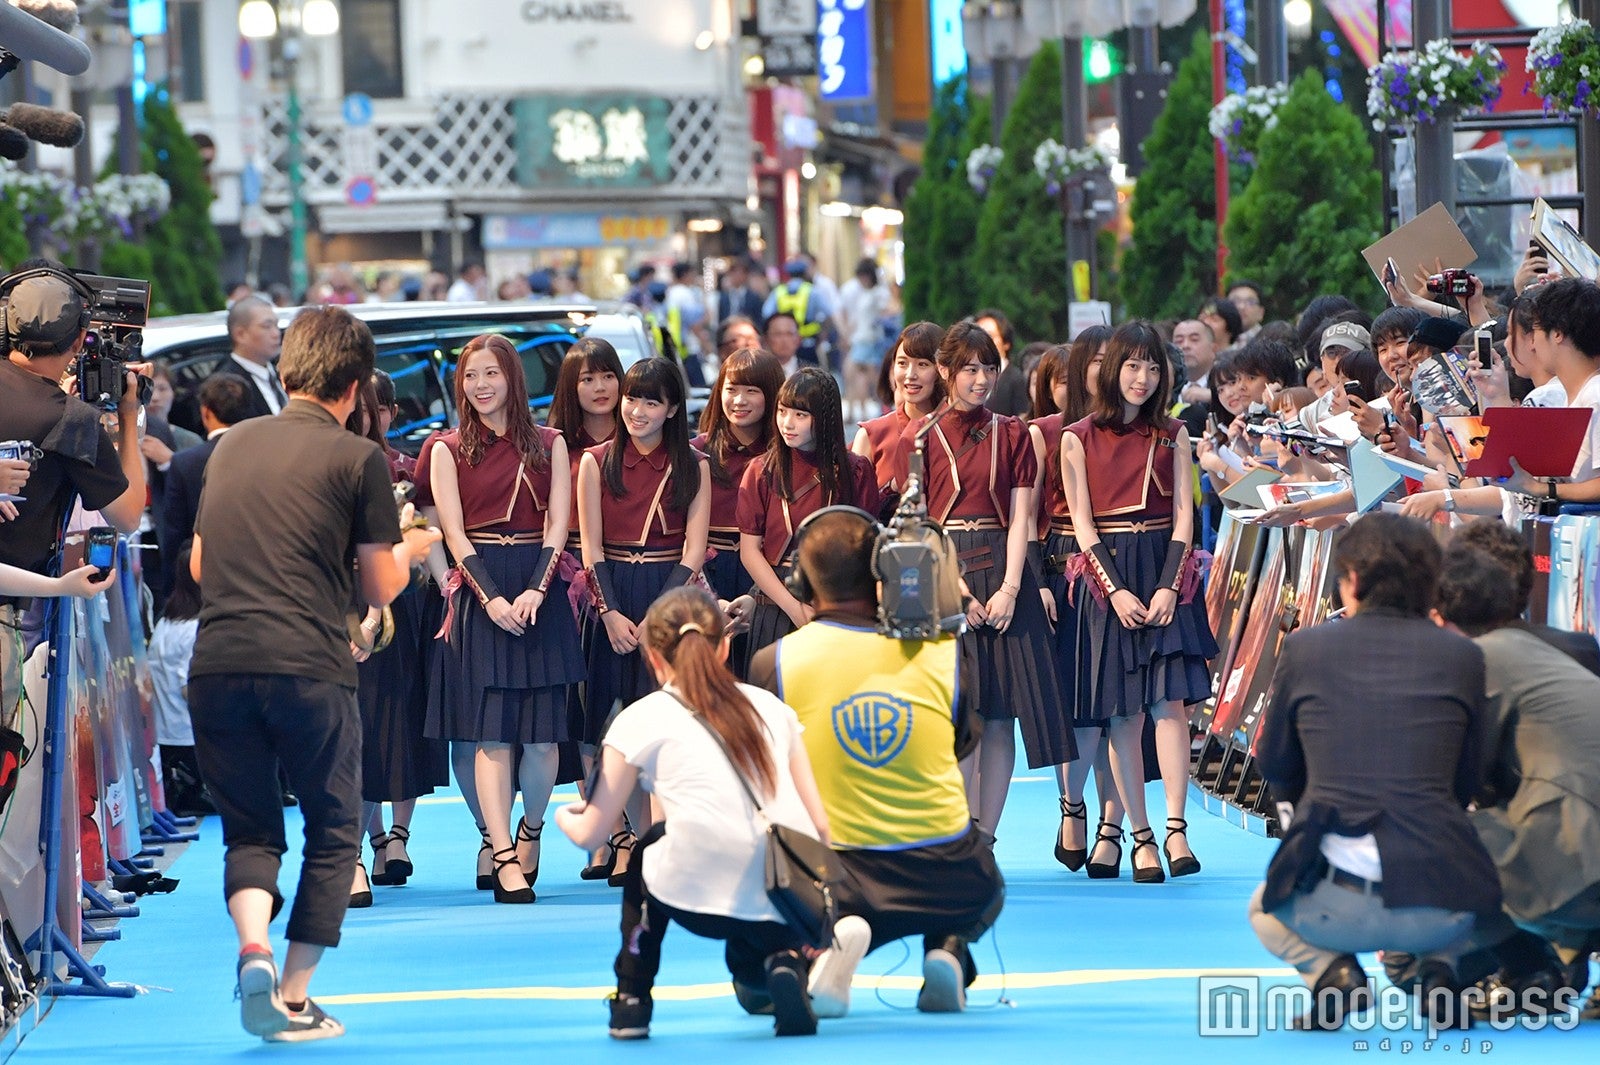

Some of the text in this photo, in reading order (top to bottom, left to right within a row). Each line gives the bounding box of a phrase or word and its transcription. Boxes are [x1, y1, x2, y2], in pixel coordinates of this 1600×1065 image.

[520, 0, 634, 22] CHANEL
[1326, 325, 1359, 338] USN
[842, 700, 901, 758] WB
